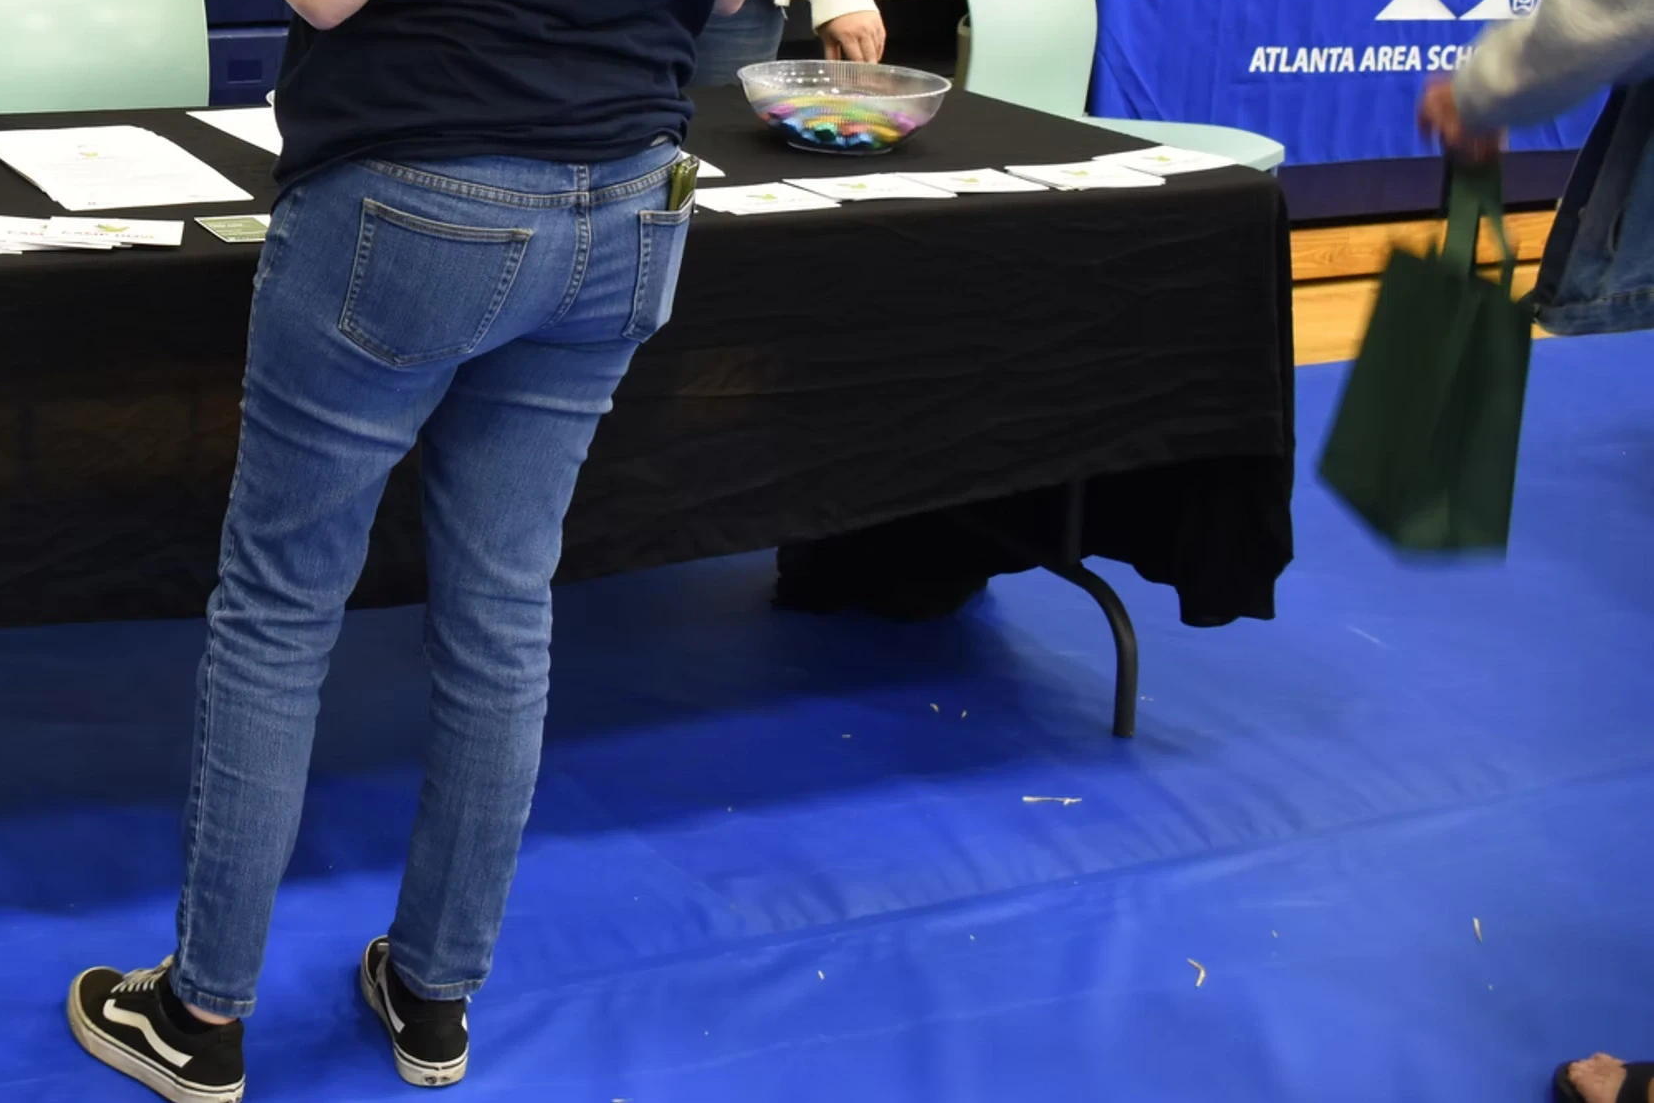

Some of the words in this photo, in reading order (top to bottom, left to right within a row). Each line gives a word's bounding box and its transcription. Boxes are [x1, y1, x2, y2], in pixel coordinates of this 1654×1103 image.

[1248, 46, 1355, 73] ATLANTA
[1358, 45, 1422, 72] AREA
[1426, 44, 1474, 71] SCH
